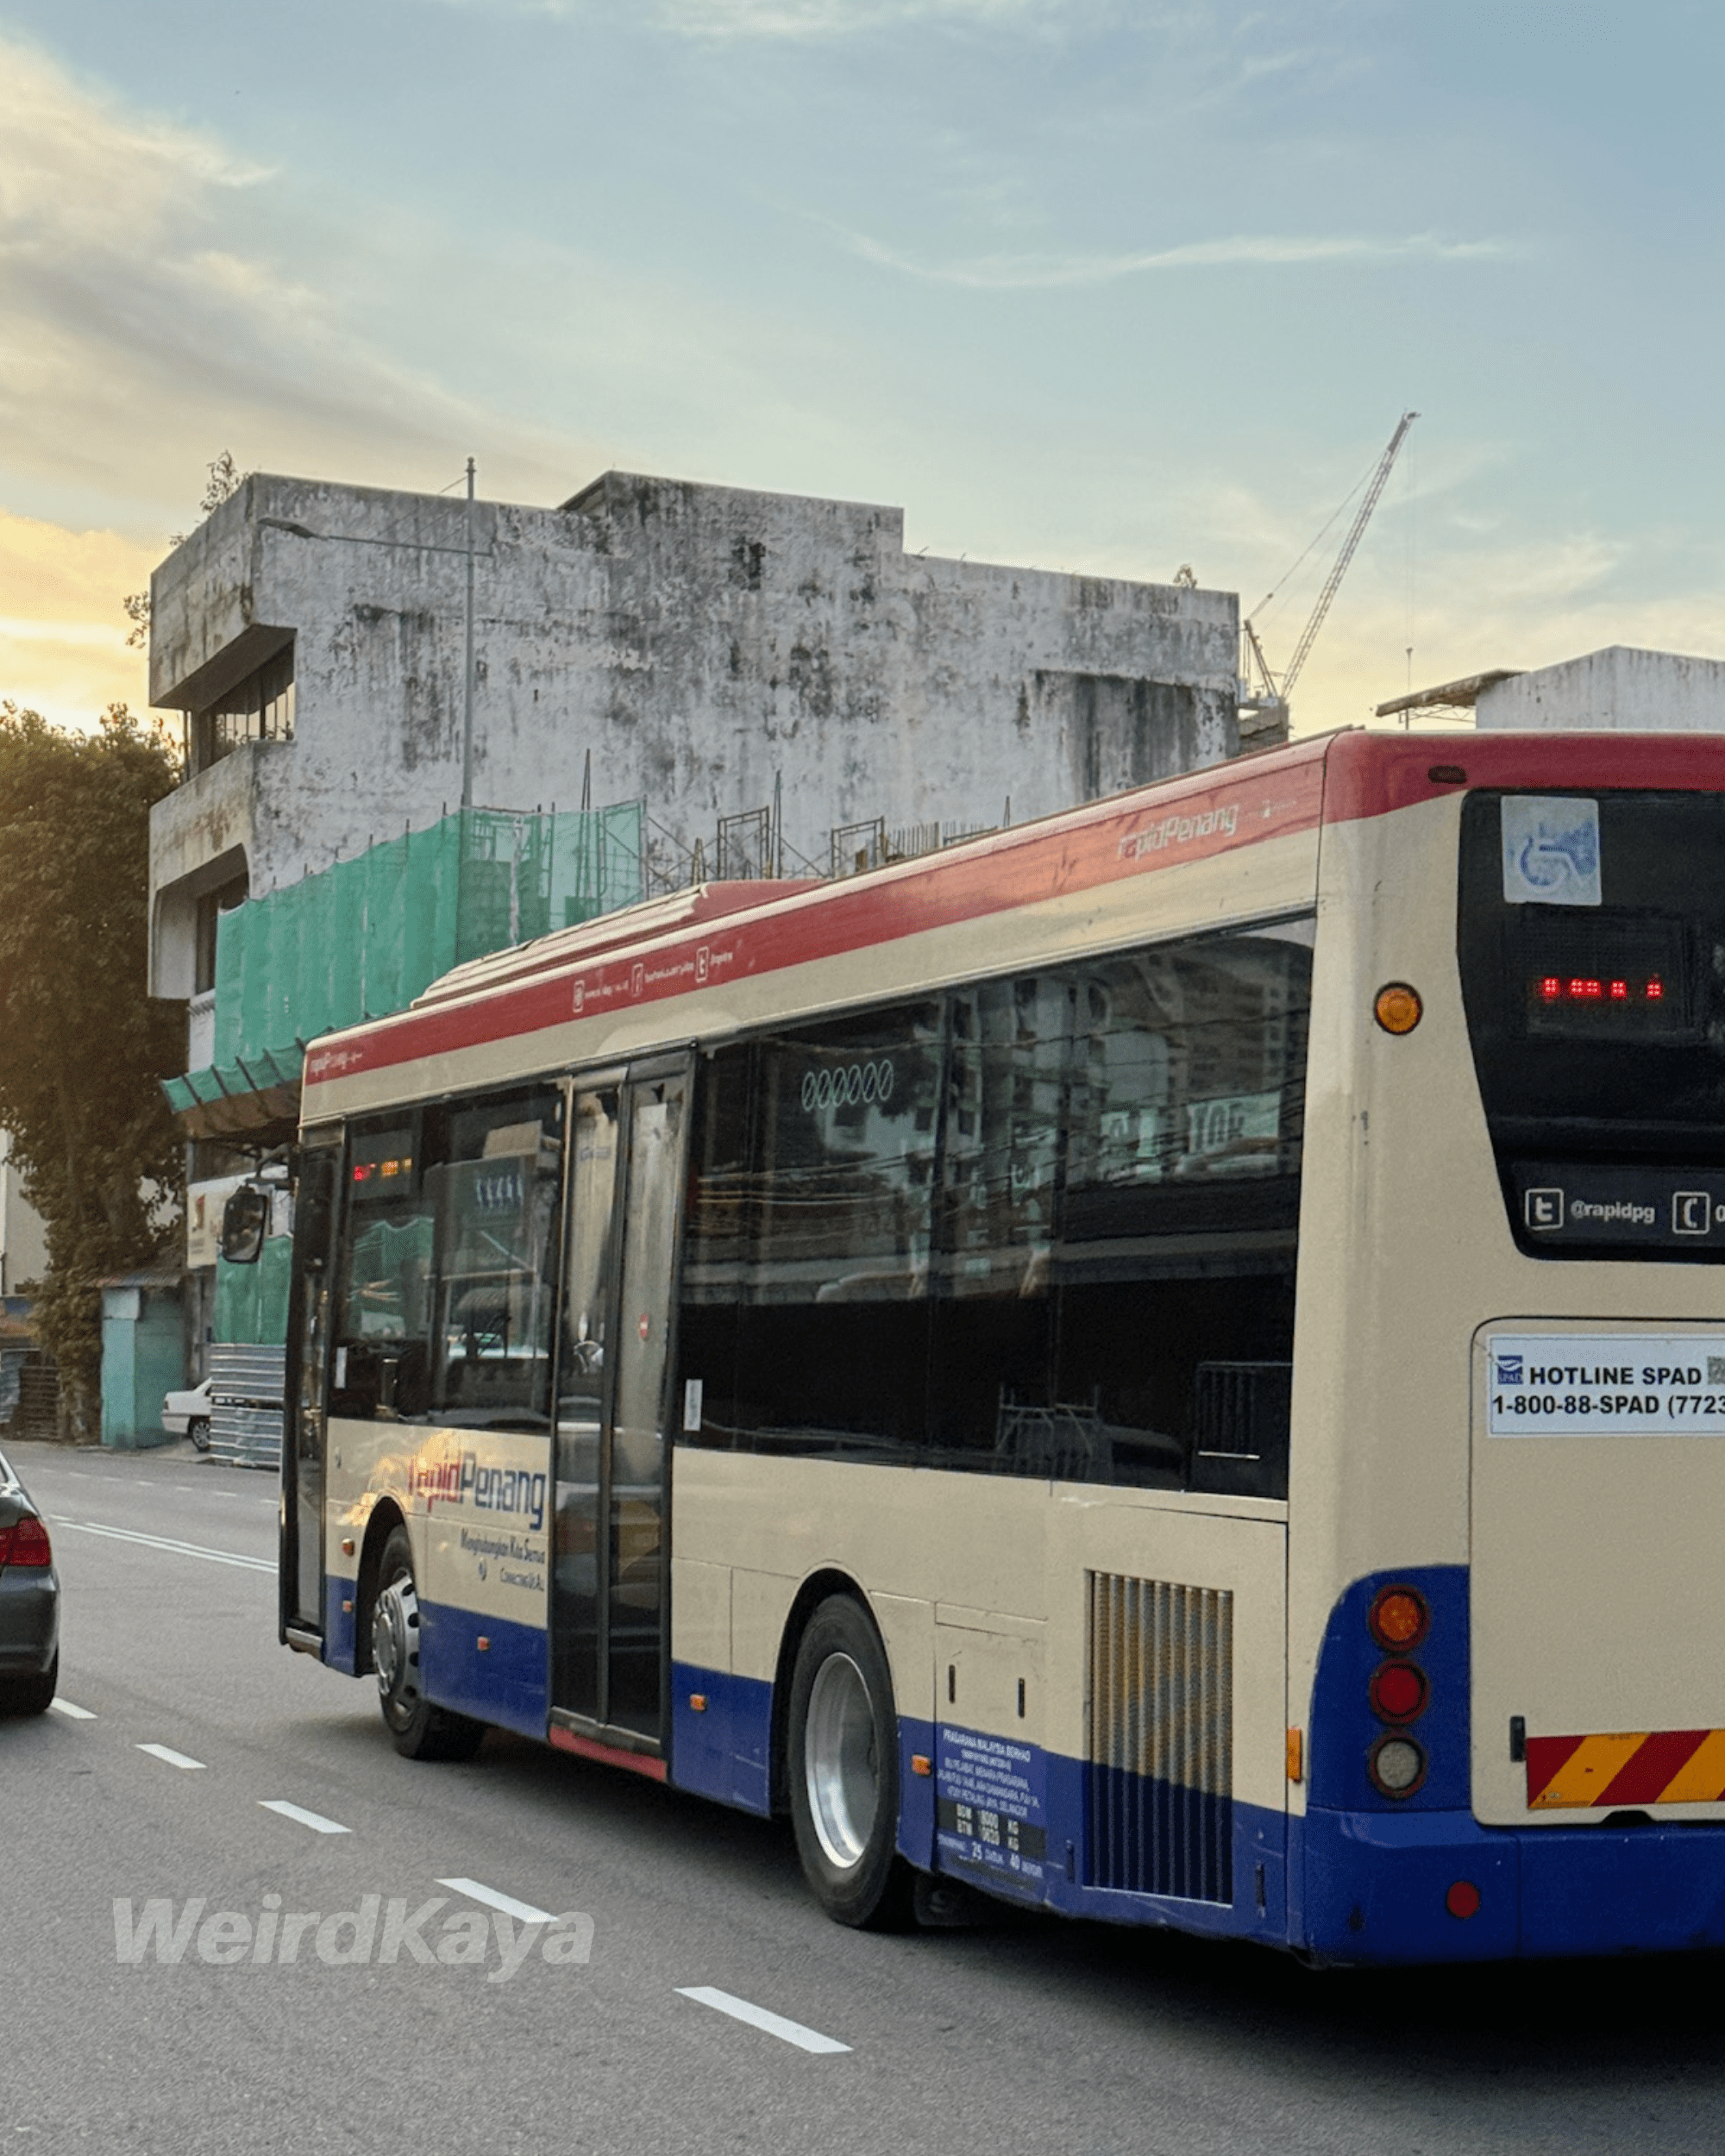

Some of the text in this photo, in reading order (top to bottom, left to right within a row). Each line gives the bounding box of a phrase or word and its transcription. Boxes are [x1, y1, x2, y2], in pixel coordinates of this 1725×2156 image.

[1570, 1200, 1655, 1224] @rapidpg
[1529, 1367, 1702, 1385] HOTLINE SPAD
[1493, 1395, 1659, 1414] 1-800-88-SPAD
